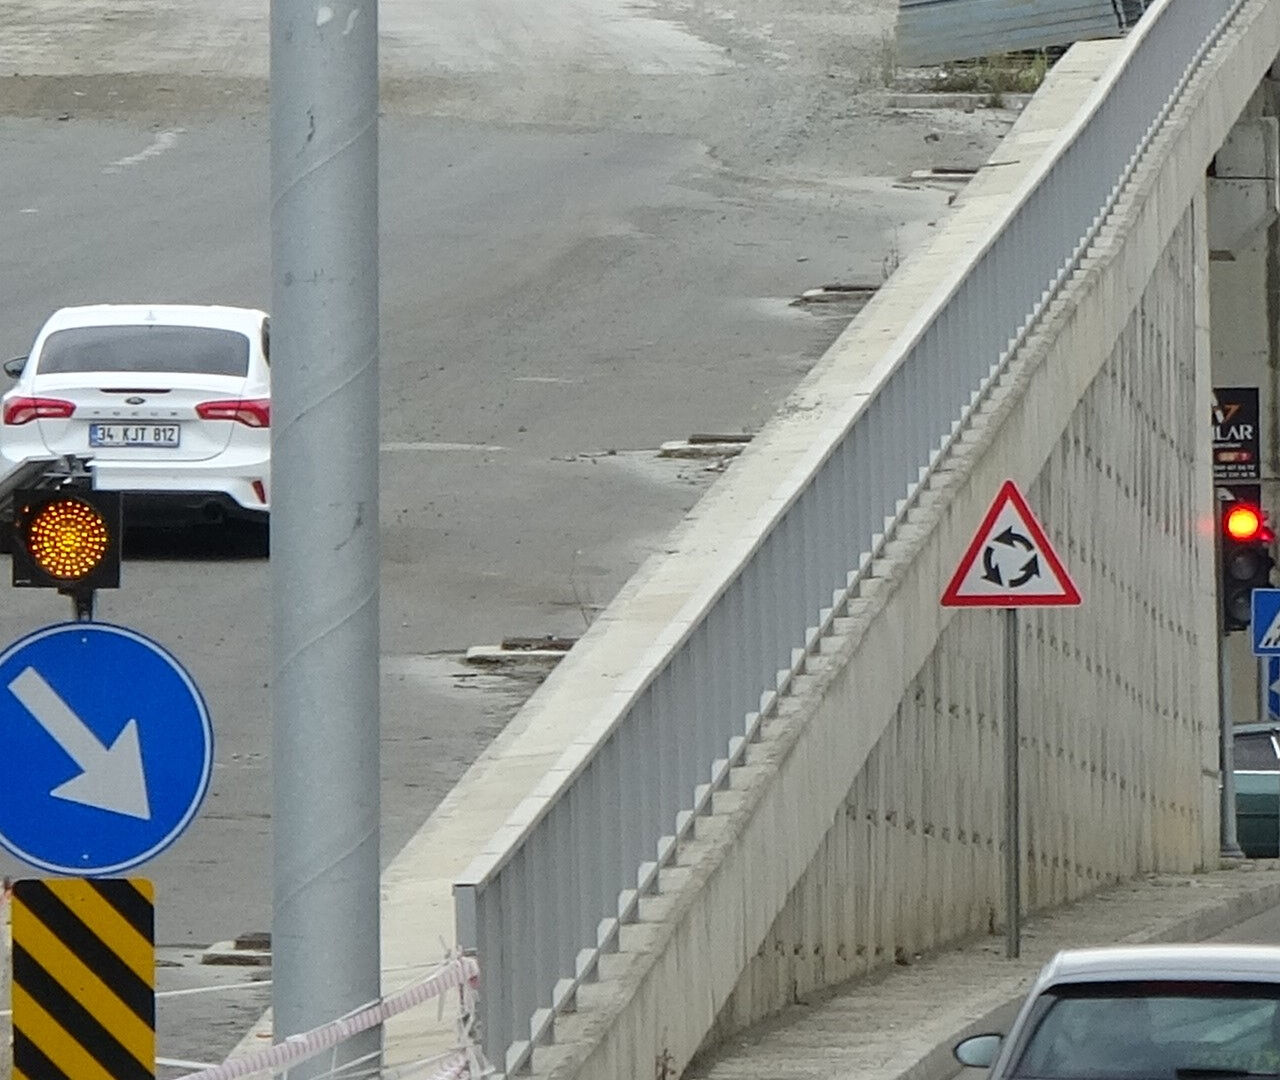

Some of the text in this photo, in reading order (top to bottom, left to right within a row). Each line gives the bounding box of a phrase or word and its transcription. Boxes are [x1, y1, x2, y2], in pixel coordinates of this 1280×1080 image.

[98, 427, 175, 441] 34 KJT 812
